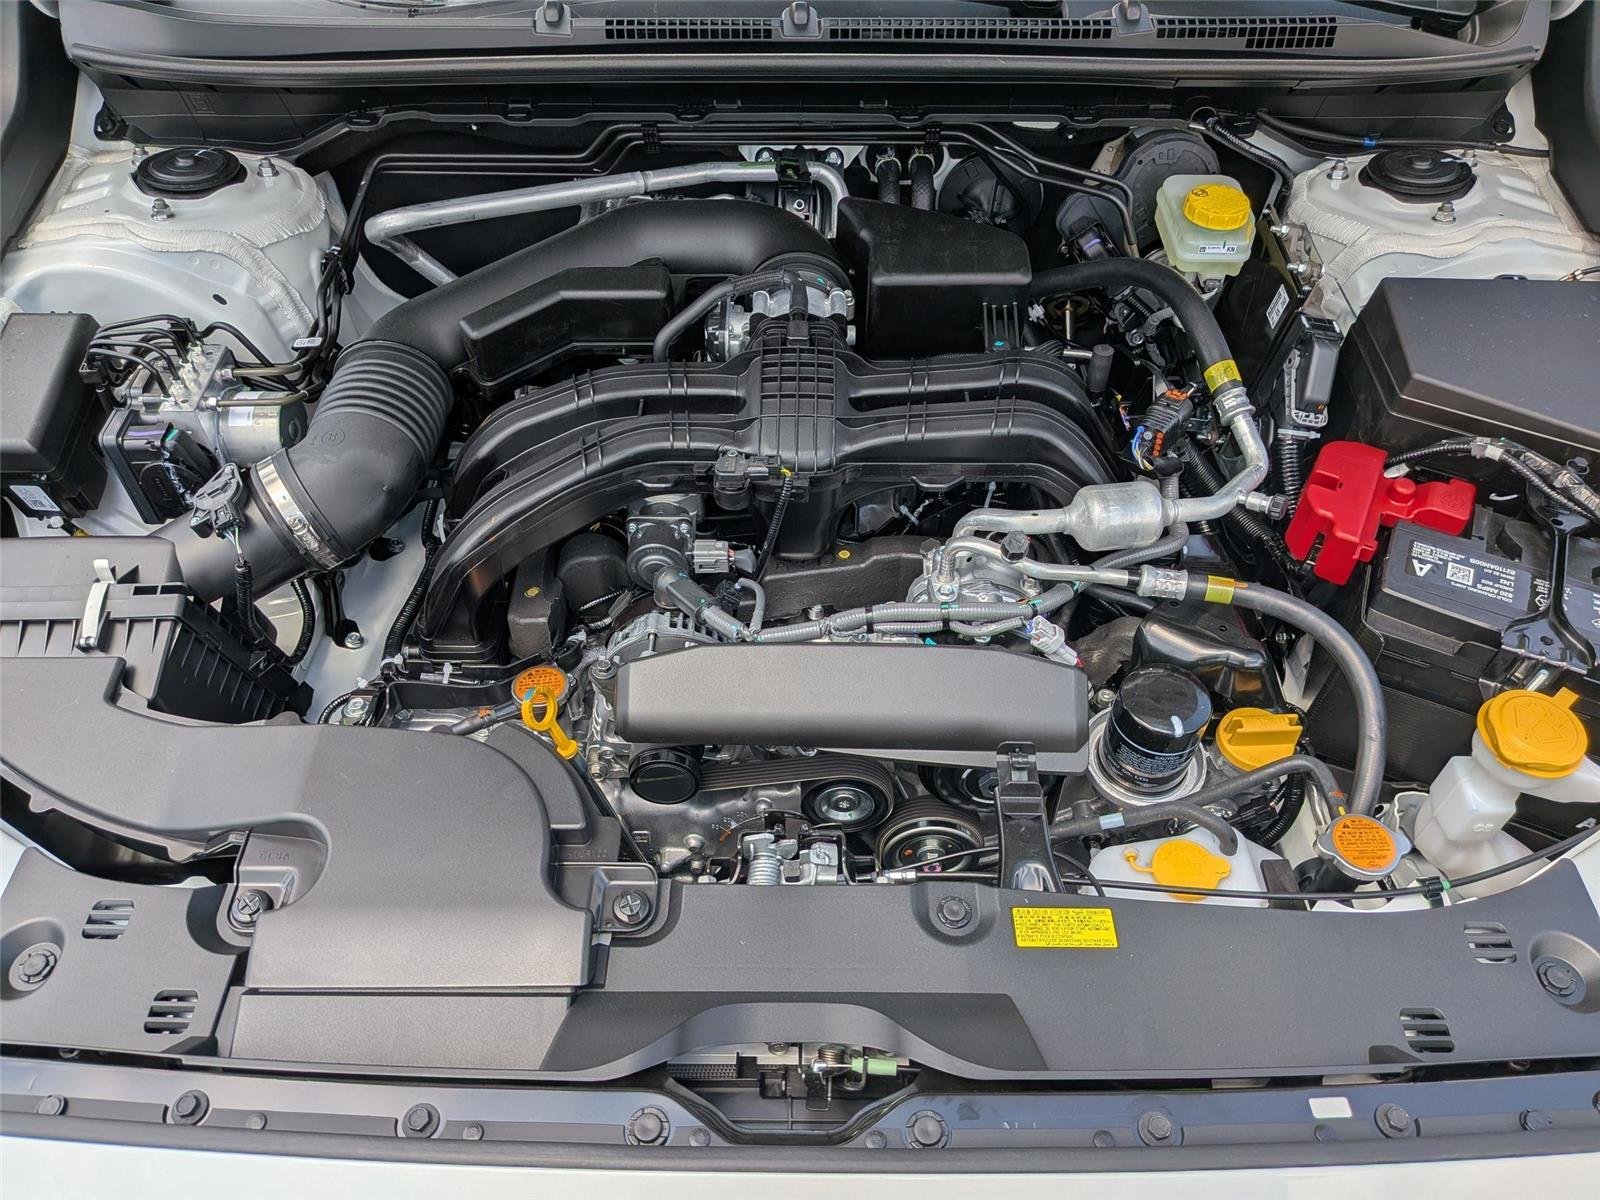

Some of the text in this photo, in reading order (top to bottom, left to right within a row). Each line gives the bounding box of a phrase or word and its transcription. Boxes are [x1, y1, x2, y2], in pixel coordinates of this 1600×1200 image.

[1480, 578, 1514, 592] GROUP SIZE
[1499, 578, 1514, 587] LN2
[1451, 581, 1513, 603] COLD CRANKING AMPS
[1476, 583, 1513, 599] 620 AMPS
